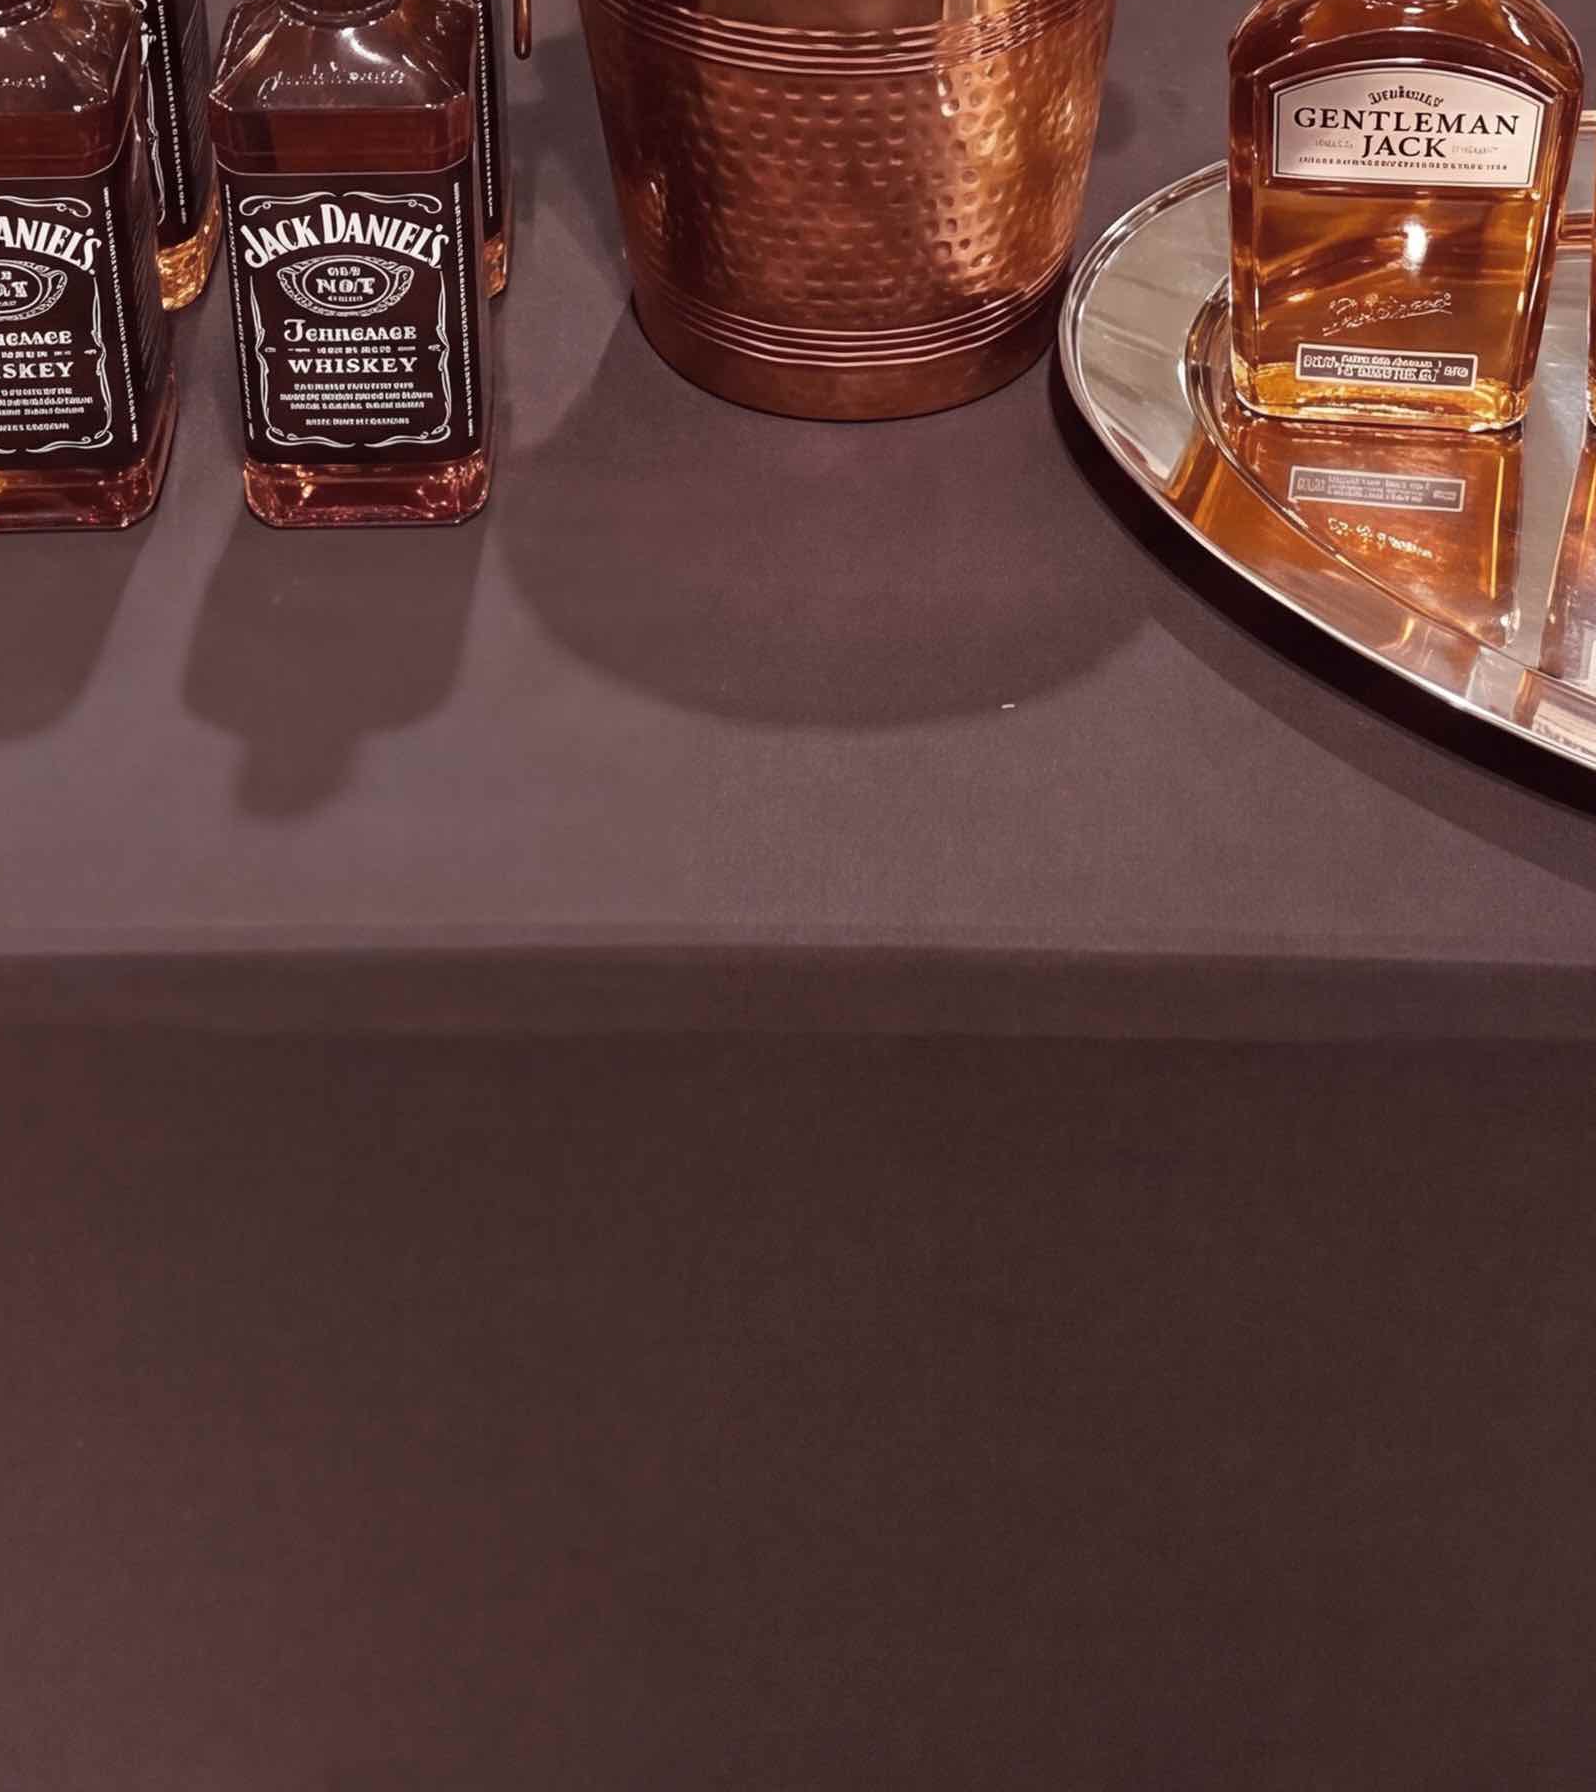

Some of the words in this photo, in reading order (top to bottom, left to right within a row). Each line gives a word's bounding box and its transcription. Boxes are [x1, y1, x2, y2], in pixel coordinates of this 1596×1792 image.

[1294, 107, 1520, 135] GENTLEMAN
[1361, 135, 1447, 158] JACK
[240, 215, 320, 268] JACK
[320, 204, 449, 269] DANIEL'S
[288, 357, 418, 373] WHISKEY
